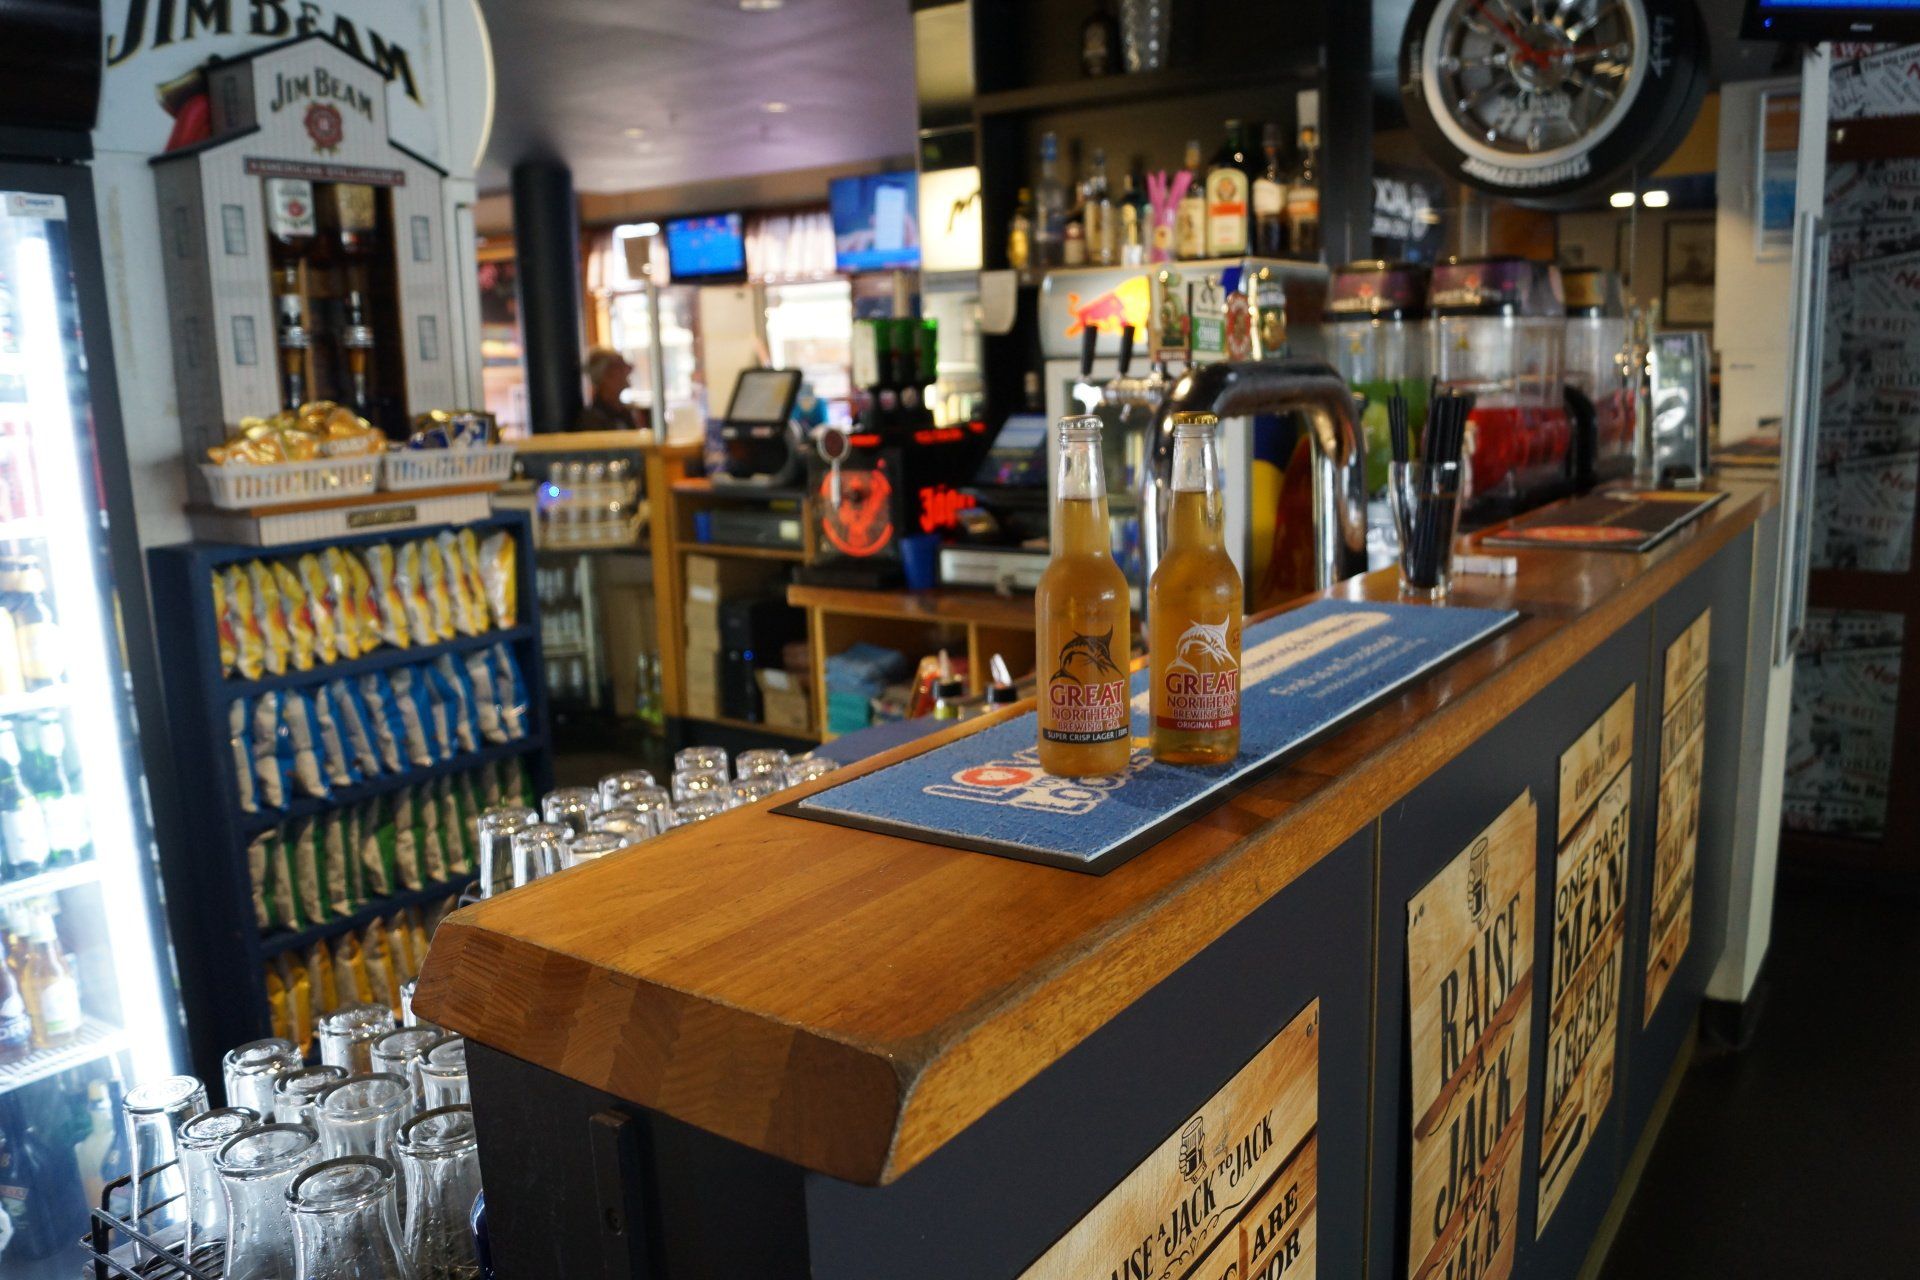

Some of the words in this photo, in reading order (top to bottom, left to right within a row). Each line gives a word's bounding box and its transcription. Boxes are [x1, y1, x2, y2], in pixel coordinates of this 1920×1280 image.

[105, 0, 232, 67] JIM
[249, 0, 422, 107] BEAM
[270, 72, 311, 113] JIM
[315, 65, 374, 123] BEAM
[1049, 679, 1125, 707] GREAT
[1165, 668, 1238, 696] GREAT
[1166, 691, 1237, 709] NORTHERN
[1050, 702, 1124, 721] NORTHERN
[1058, 721, 1104, 732] BREWING
[1173, 708, 1218, 720] BREWING
[1177, 720, 1213, 729] ORIGINAL
[1047, 731, 1068, 741] SUPER
[1069, 733, 1091, 742] CRISP
[1092, 731, 1115, 741] LAGER
[1556, 851, 1589, 923] ONE
[1592, 802, 1629, 879] PART
[1555, 838, 1626, 1004] MAN
[1438, 890, 1521, 1094] RAISE
[1473, 1042, 1486, 1088] A
[1433, 1030, 1515, 1244] JACK
[1157, 1222, 1167, 1243] A
[1163, 1170, 1217, 1258] JACK
[1218, 1153, 1234, 1178] TO
[1229, 1109, 1274, 1189] JACK
[1250, 1181, 1299, 1265] ARE
